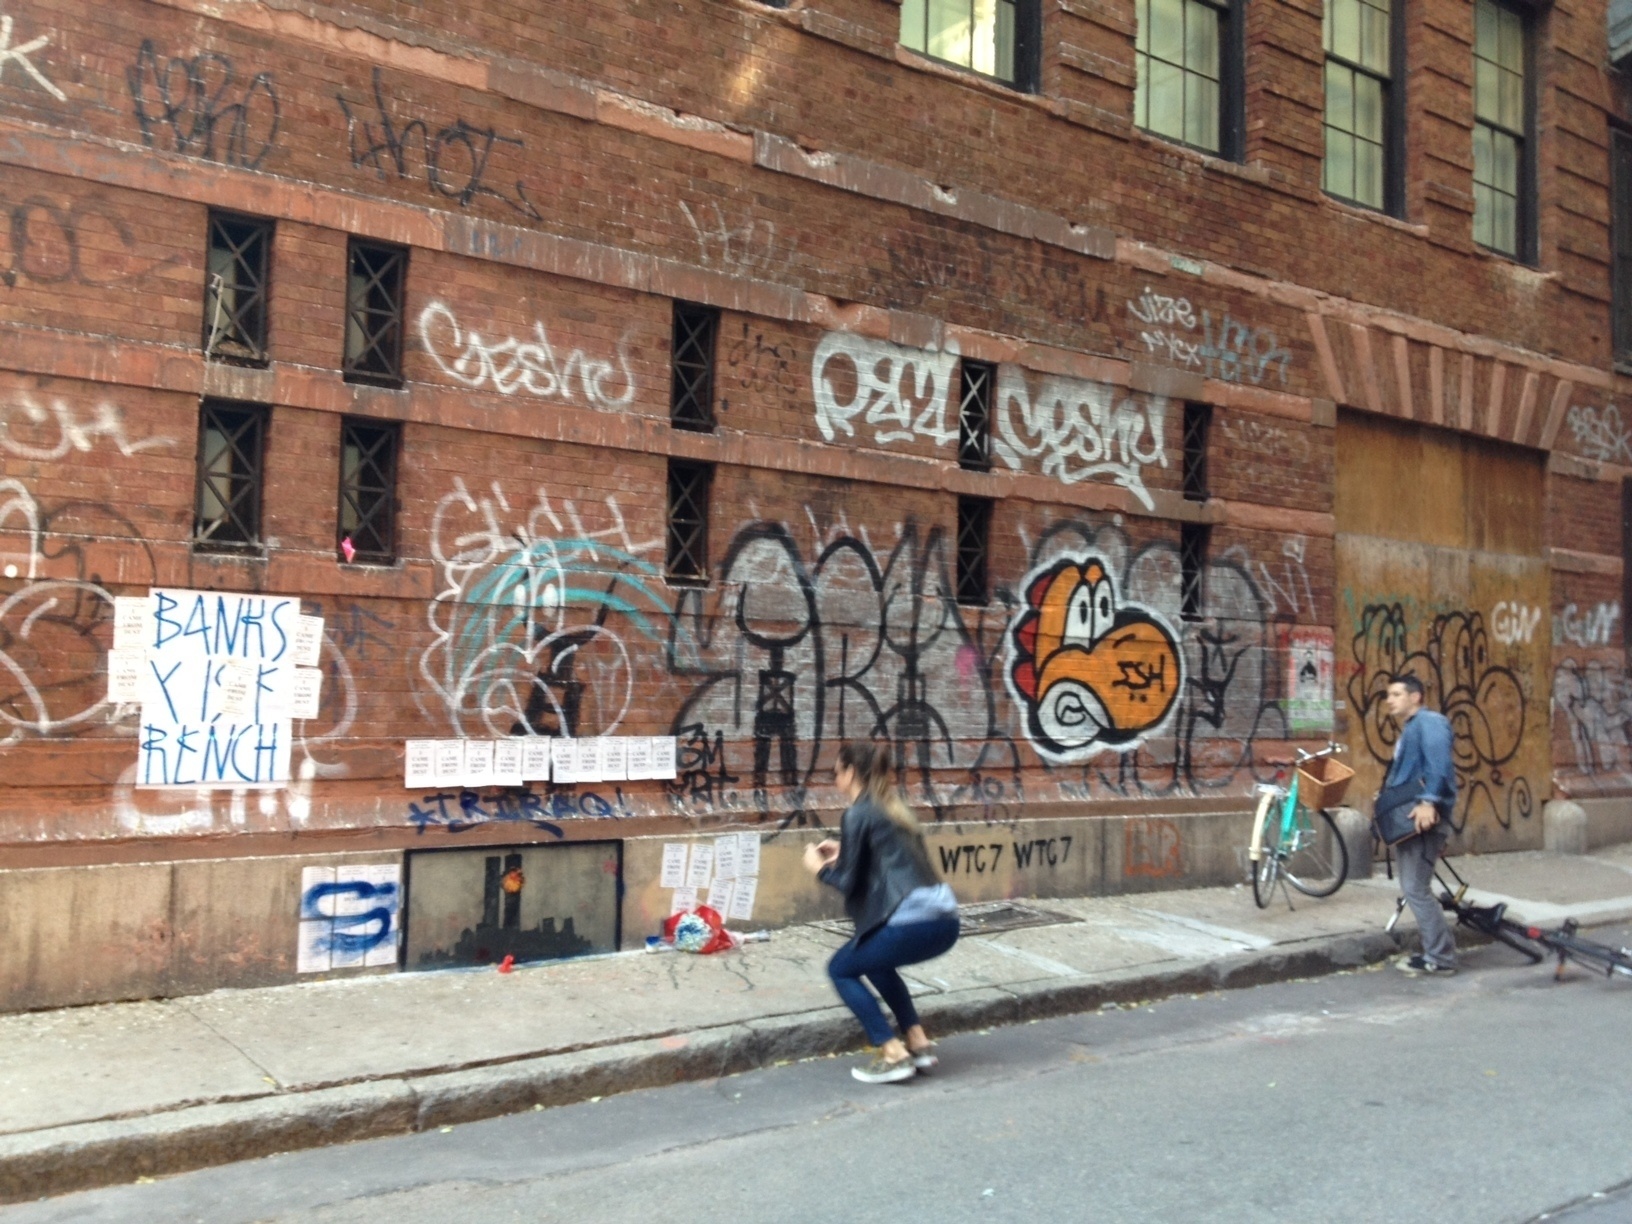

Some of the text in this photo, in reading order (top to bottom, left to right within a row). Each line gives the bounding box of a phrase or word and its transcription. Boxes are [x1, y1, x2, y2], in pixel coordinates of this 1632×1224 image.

[153, 592, 291, 662] BANKS
[141, 722, 278, 785] RENCH
[938, 835, 1073, 874] WTC7 WTC7
